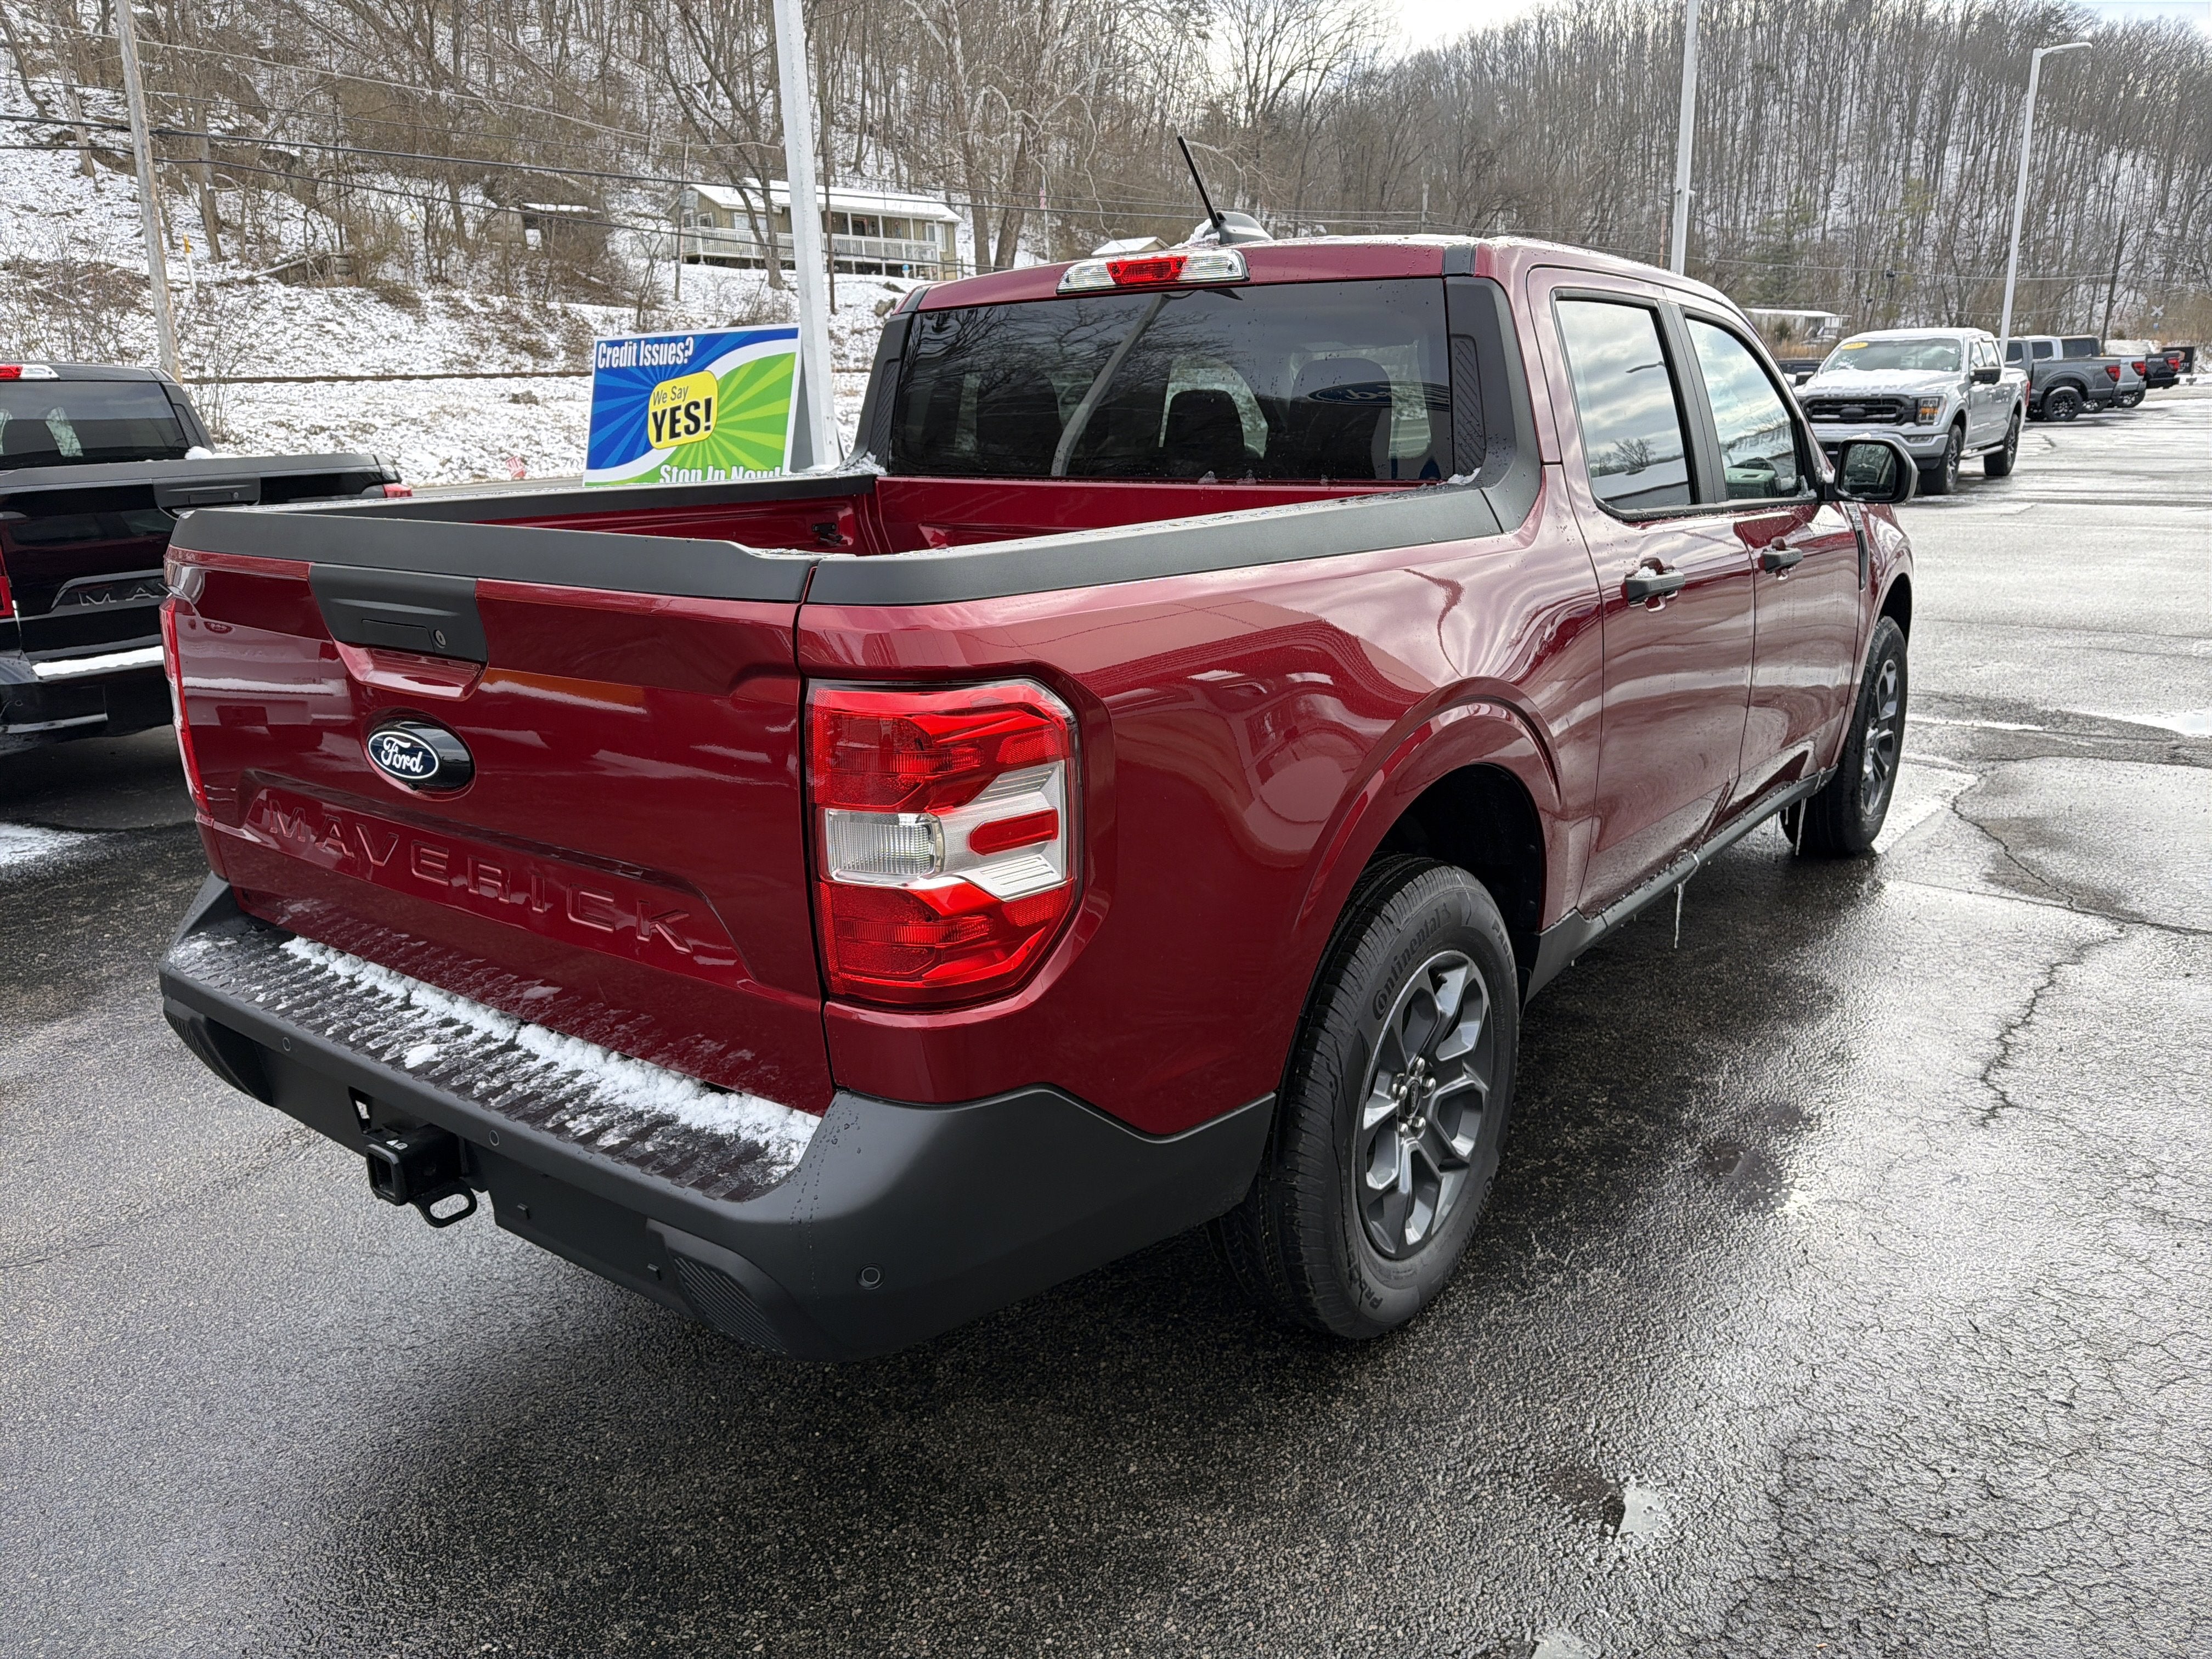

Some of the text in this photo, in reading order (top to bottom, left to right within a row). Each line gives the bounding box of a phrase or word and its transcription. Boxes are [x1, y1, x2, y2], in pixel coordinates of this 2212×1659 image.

[597, 336, 693, 369] Credit Issues?
[653, 385, 689, 406] We Say
[652, 397, 712, 443] YES!
[381, 736, 424, 773] Ford
[268, 799, 693, 953] MAVERICK
[1373, 907, 1442, 1020] Continental
